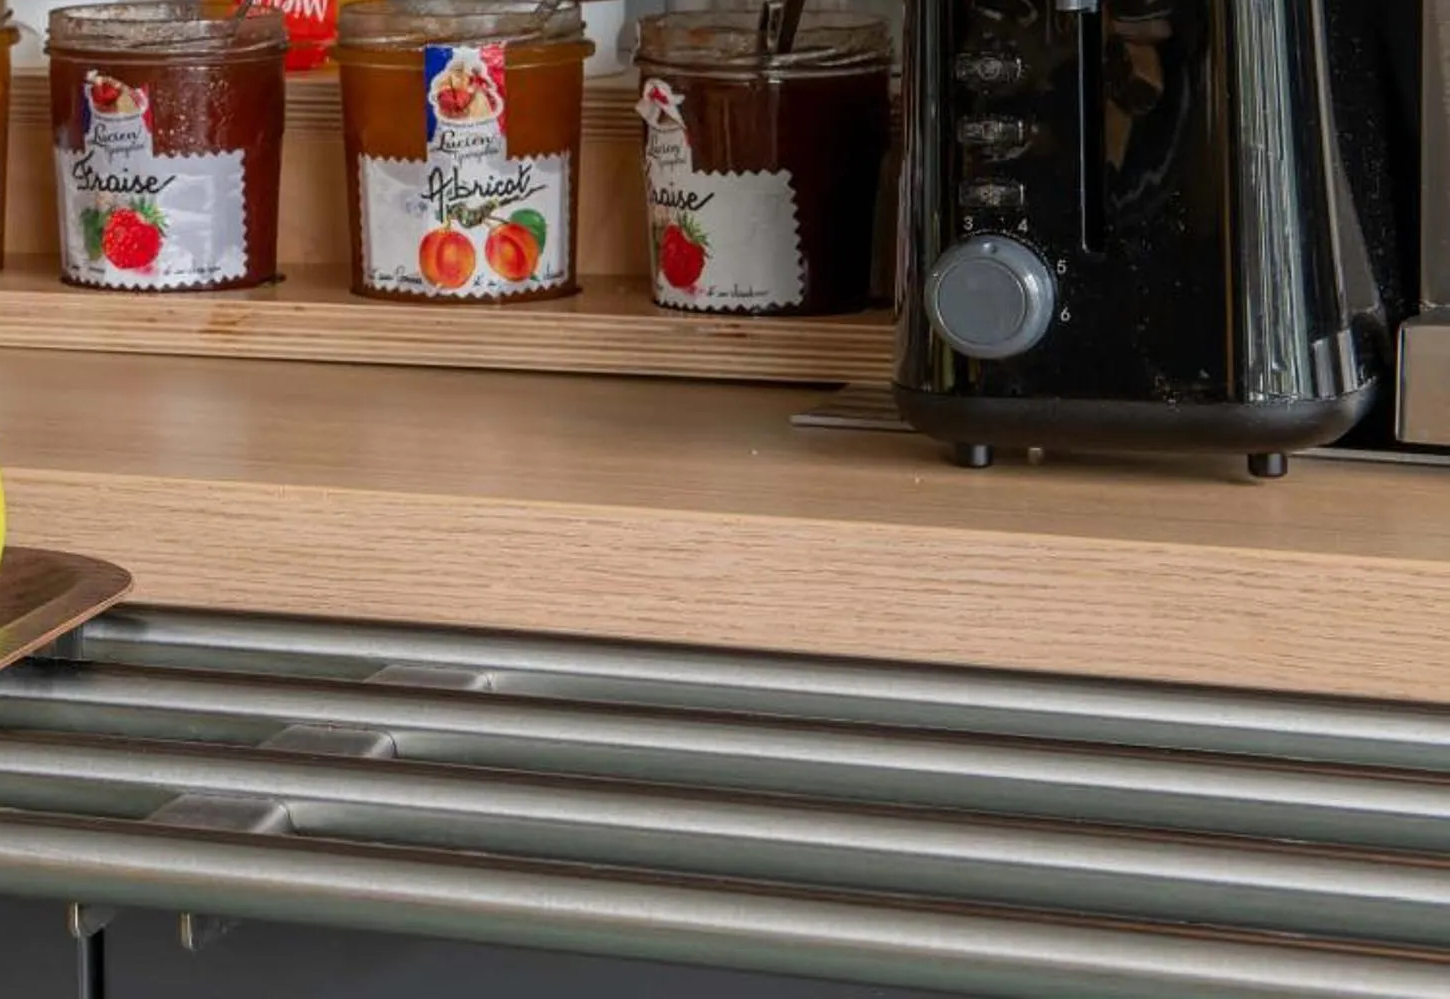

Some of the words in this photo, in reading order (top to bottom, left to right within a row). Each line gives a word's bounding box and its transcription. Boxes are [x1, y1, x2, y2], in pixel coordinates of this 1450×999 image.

[72, 151, 176, 194] Fraise
[421, 164, 547, 222] Abricot
[963, 216, 974, 231] 3
[1017, 217, 1029, 232] 4
[1056, 260, 1067, 275] 5
[1060, 306, 1072, 322] 6
